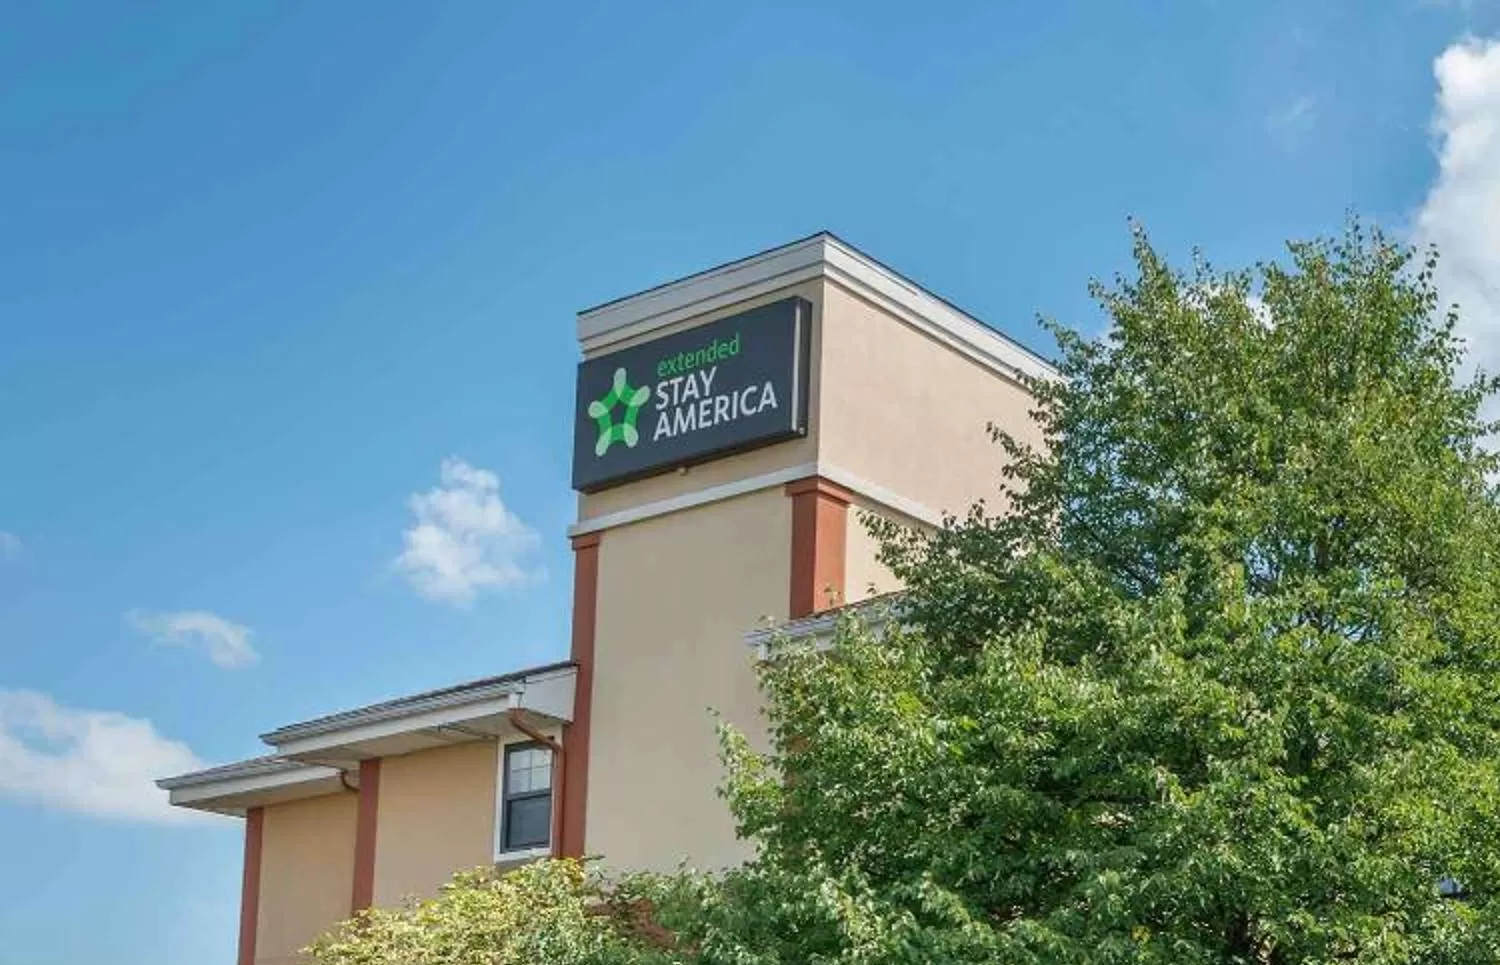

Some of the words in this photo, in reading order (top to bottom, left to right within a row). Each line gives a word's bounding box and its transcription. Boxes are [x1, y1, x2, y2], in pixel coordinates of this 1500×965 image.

[657, 333, 741, 376] extended
[655, 366, 718, 410] STAY
[653, 381, 778, 442] AMERICA
